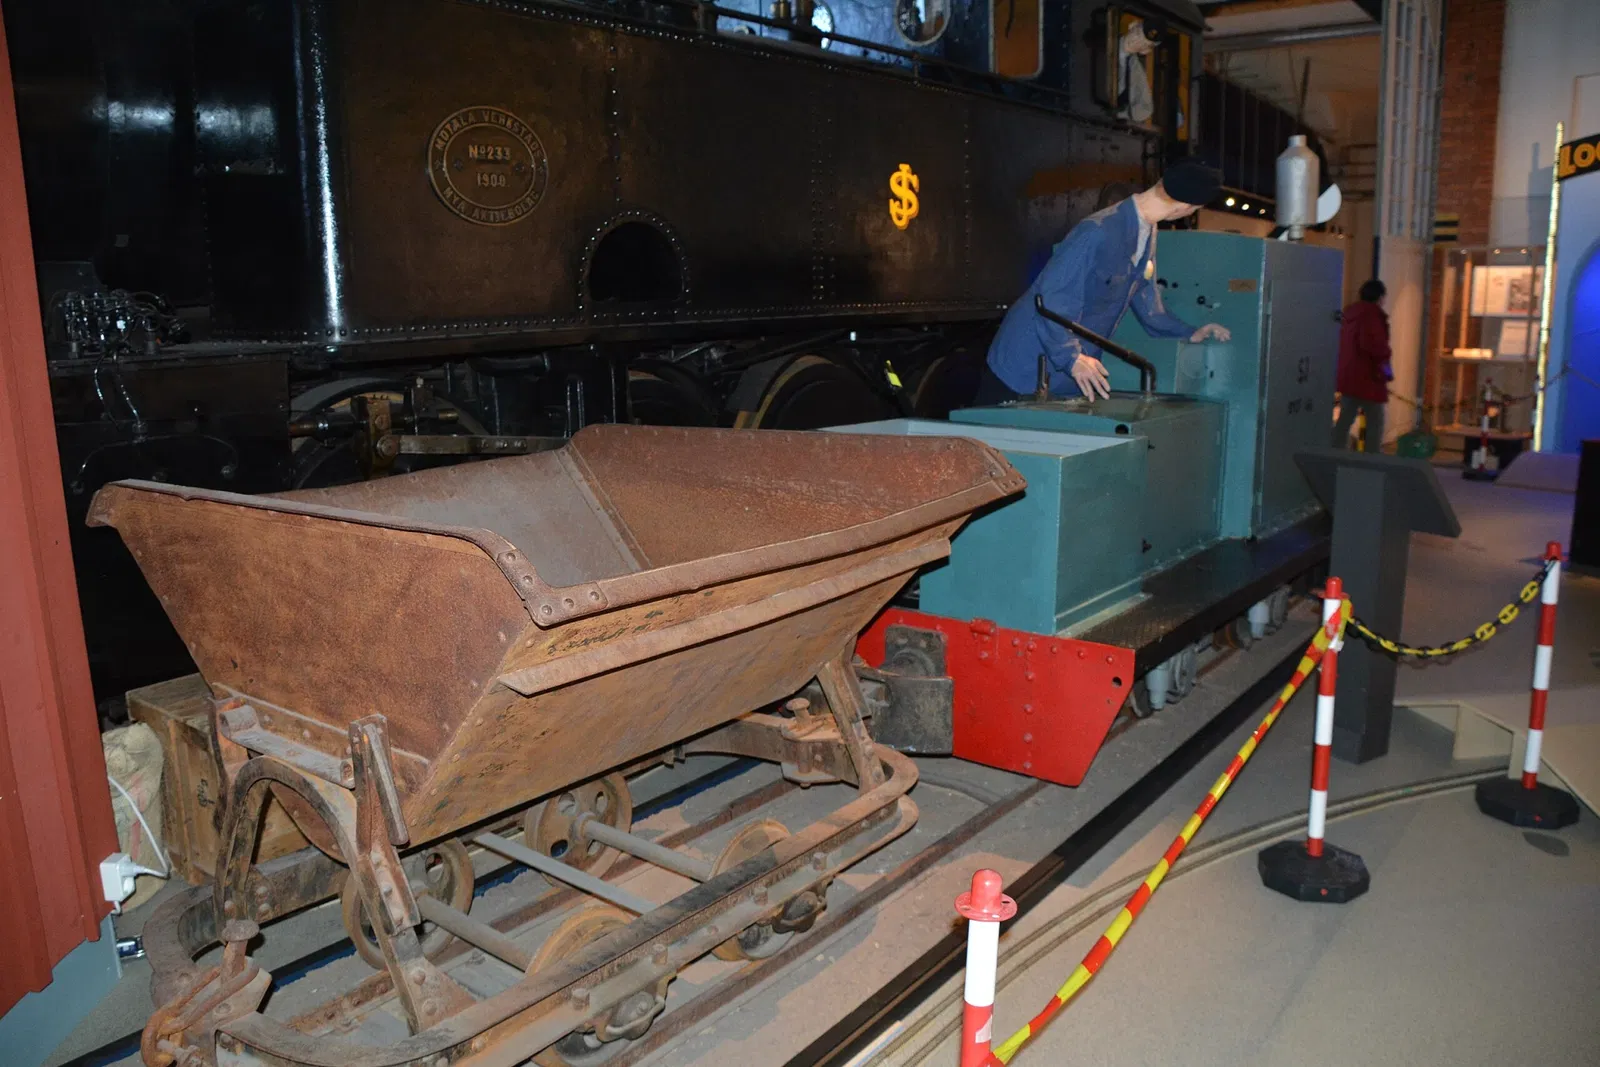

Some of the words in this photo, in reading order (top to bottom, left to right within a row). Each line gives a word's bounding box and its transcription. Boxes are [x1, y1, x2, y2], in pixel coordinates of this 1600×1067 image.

[434, 112, 476, 150] MOTALA
[1556, 138, 1600, 162] LO
[443, 187, 466, 213] NYA
